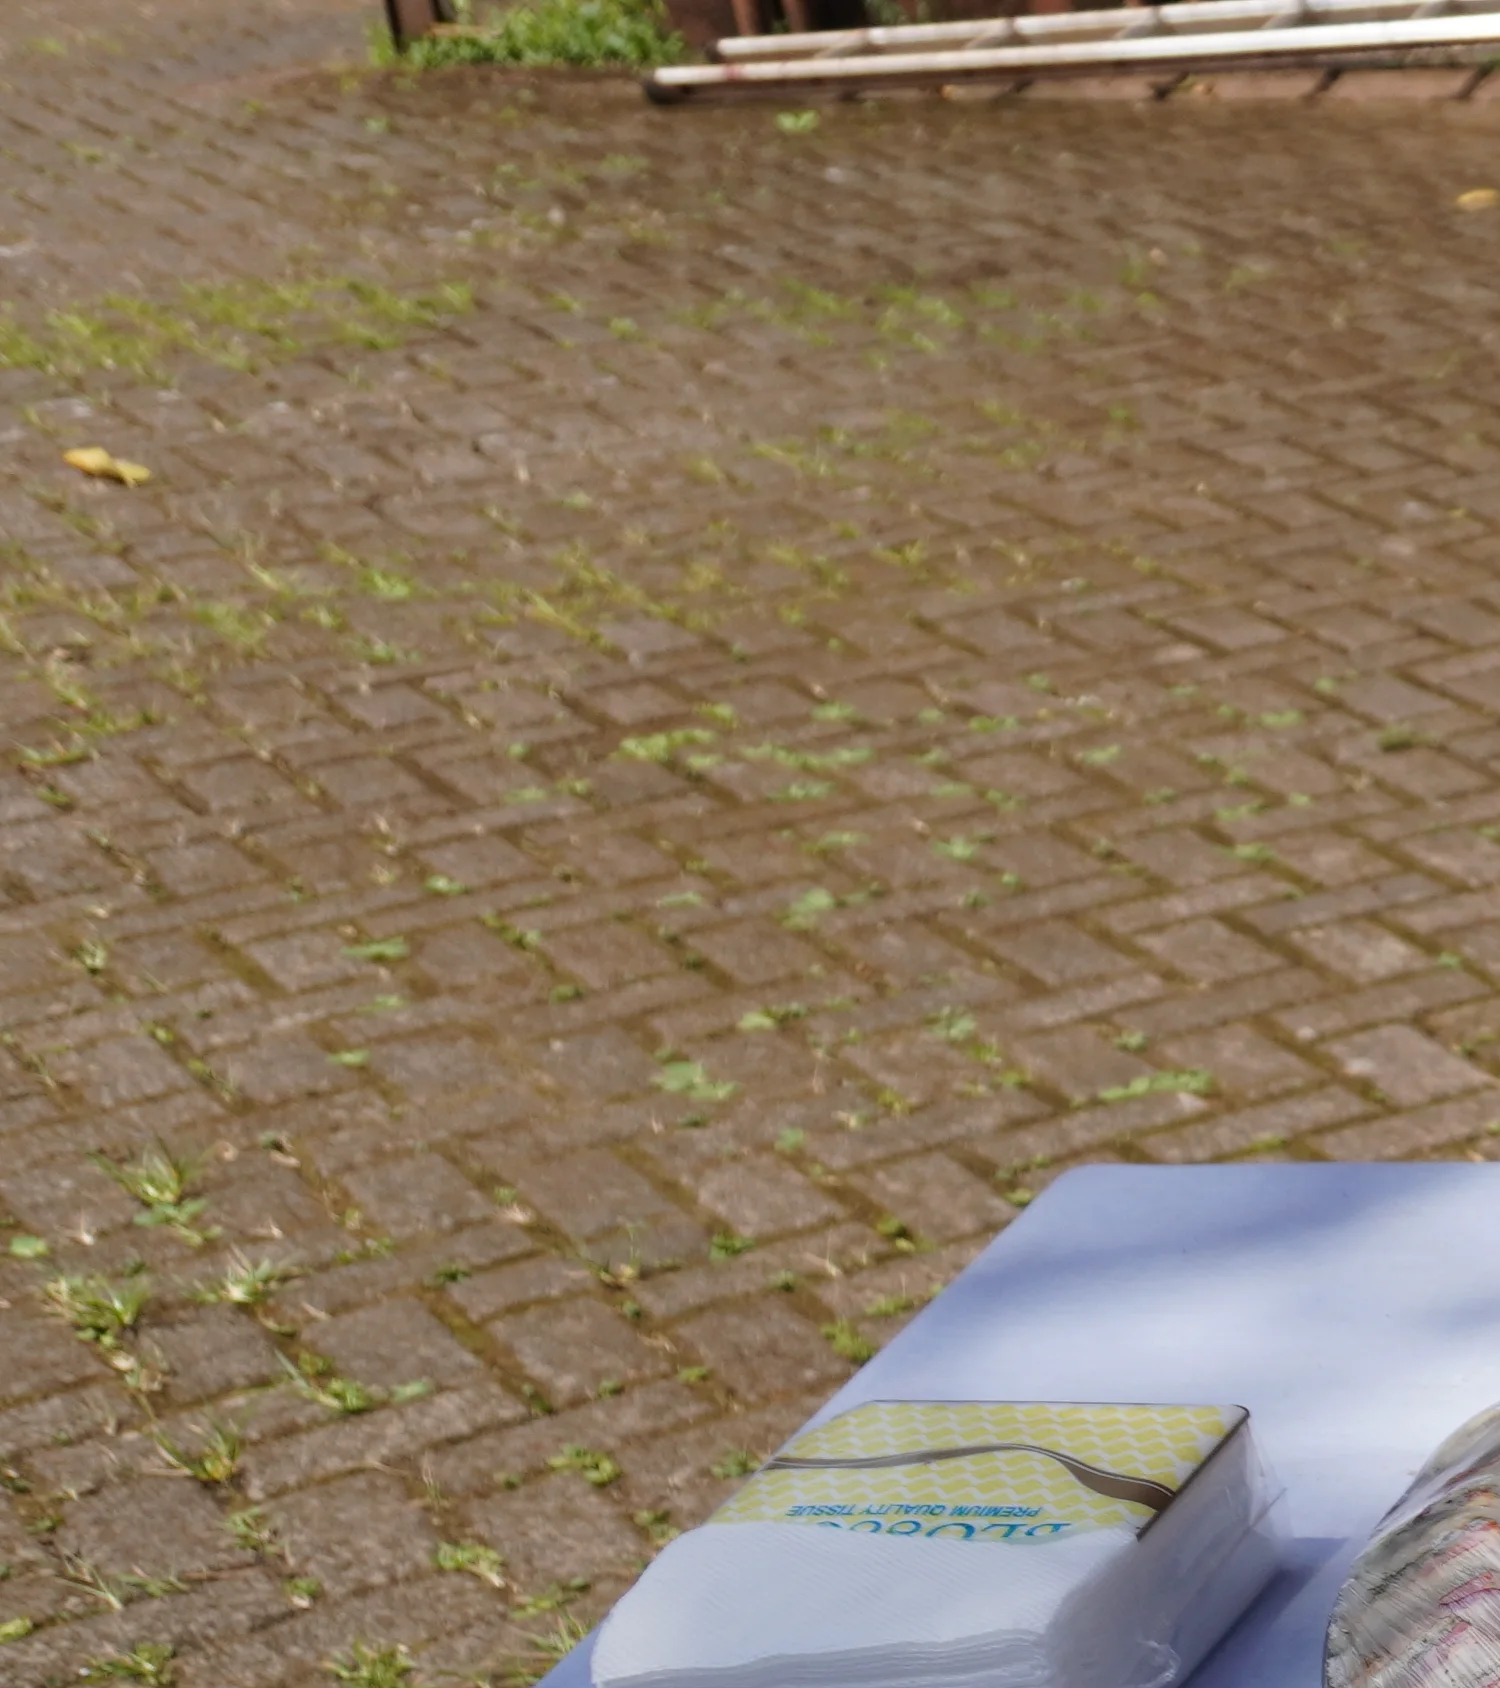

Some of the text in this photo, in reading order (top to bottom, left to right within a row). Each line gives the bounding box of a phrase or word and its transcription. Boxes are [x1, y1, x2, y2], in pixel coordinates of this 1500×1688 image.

[785, 1503, 1042, 1518] PREMIUM QUALITY TISSUE
